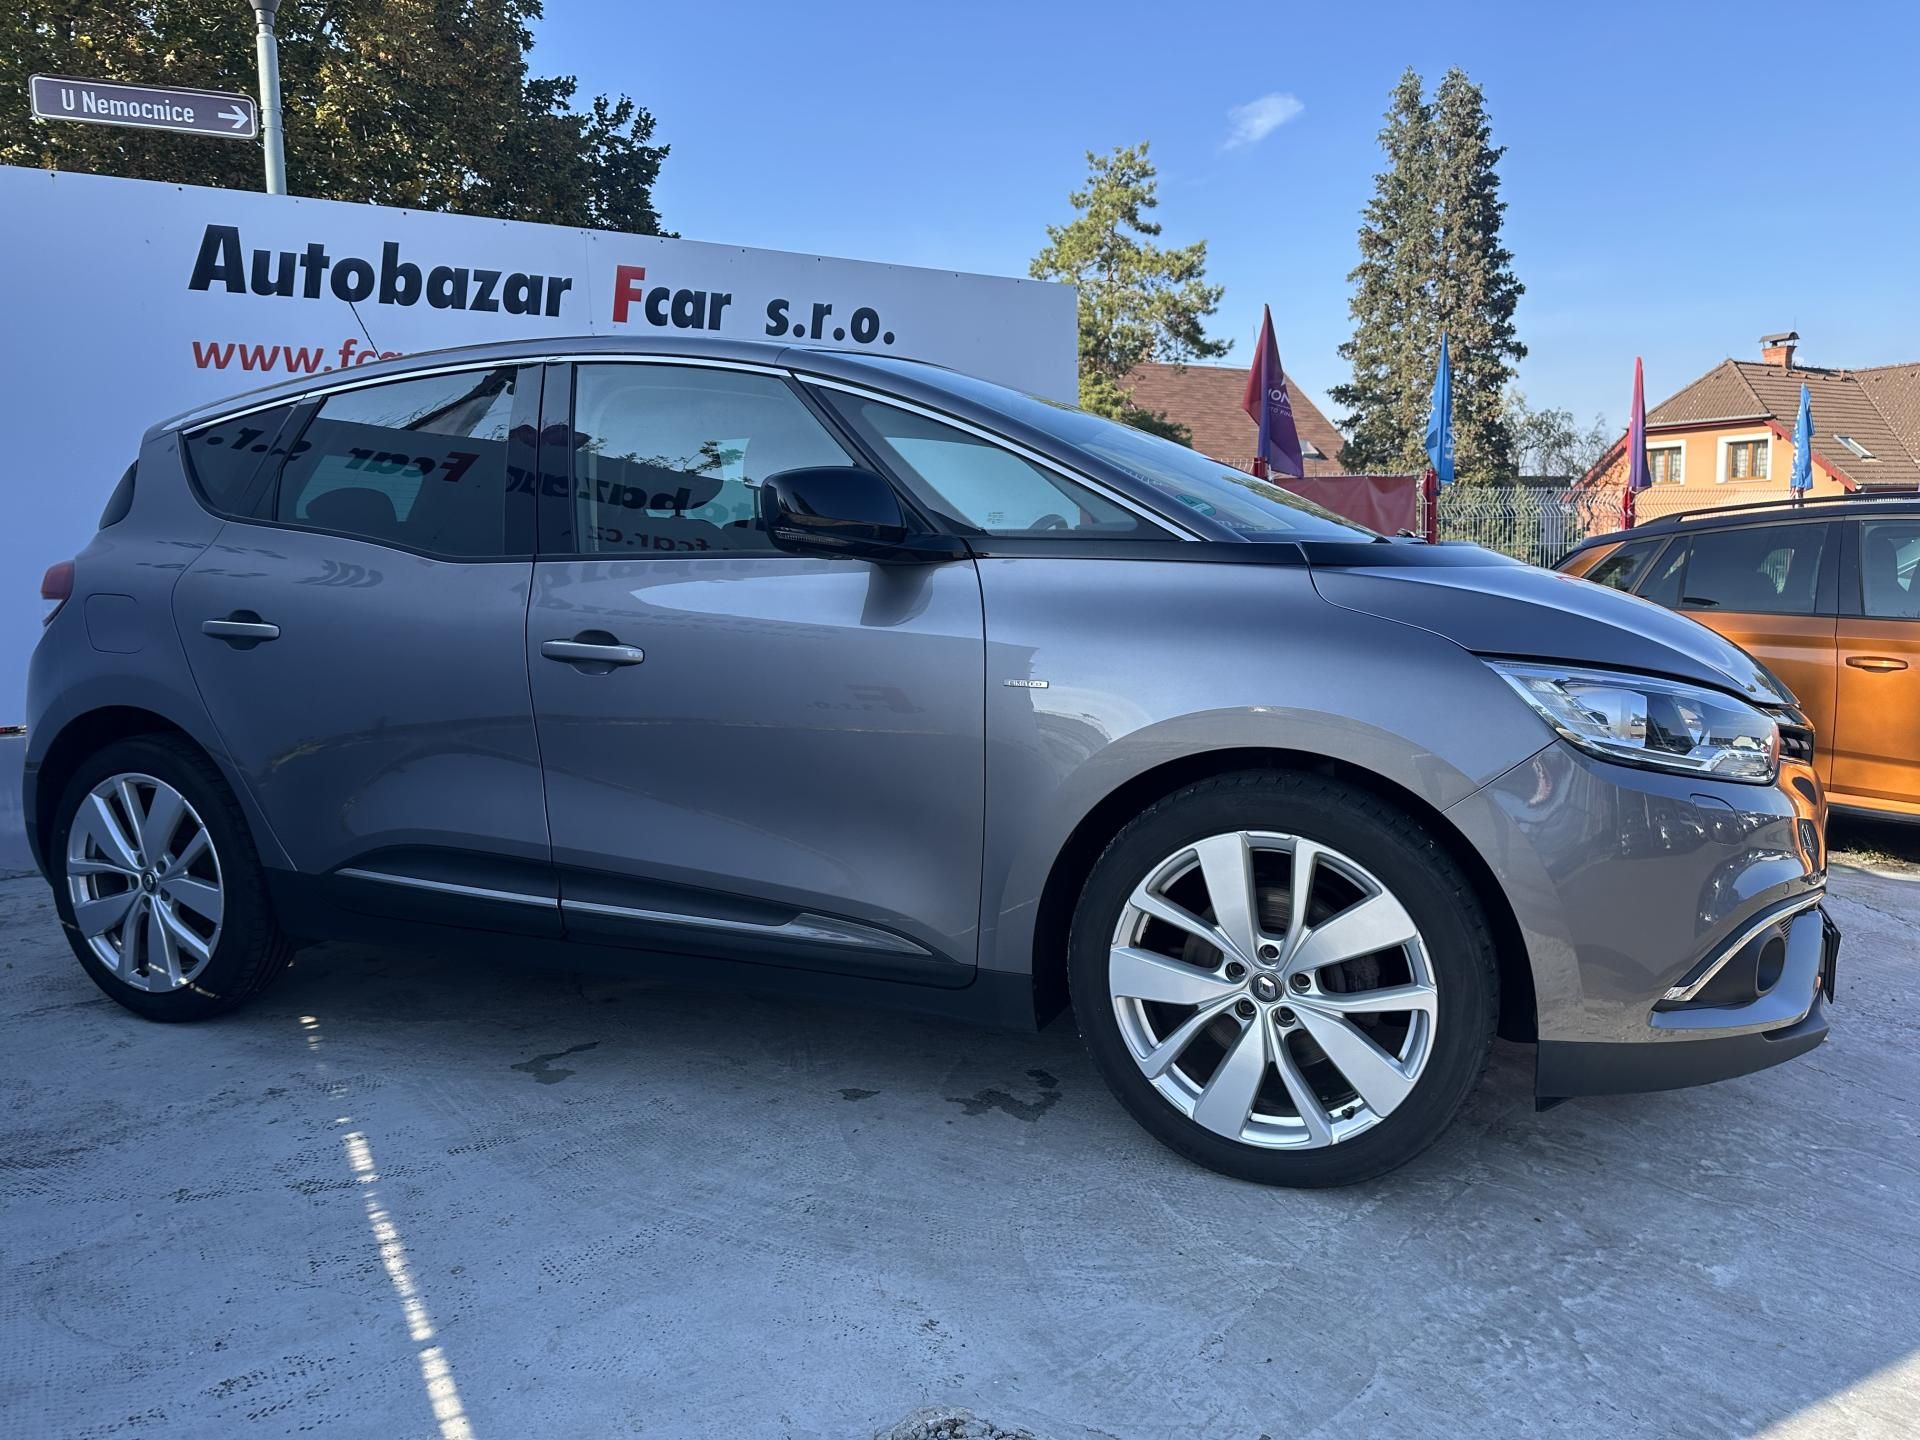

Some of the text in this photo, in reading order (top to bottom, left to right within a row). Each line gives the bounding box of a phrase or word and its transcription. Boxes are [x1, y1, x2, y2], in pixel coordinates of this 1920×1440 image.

[61, 88, 195, 124] U Nemocnice
[188, 224, 895, 345] Autobazar Fcar s.r.o.
